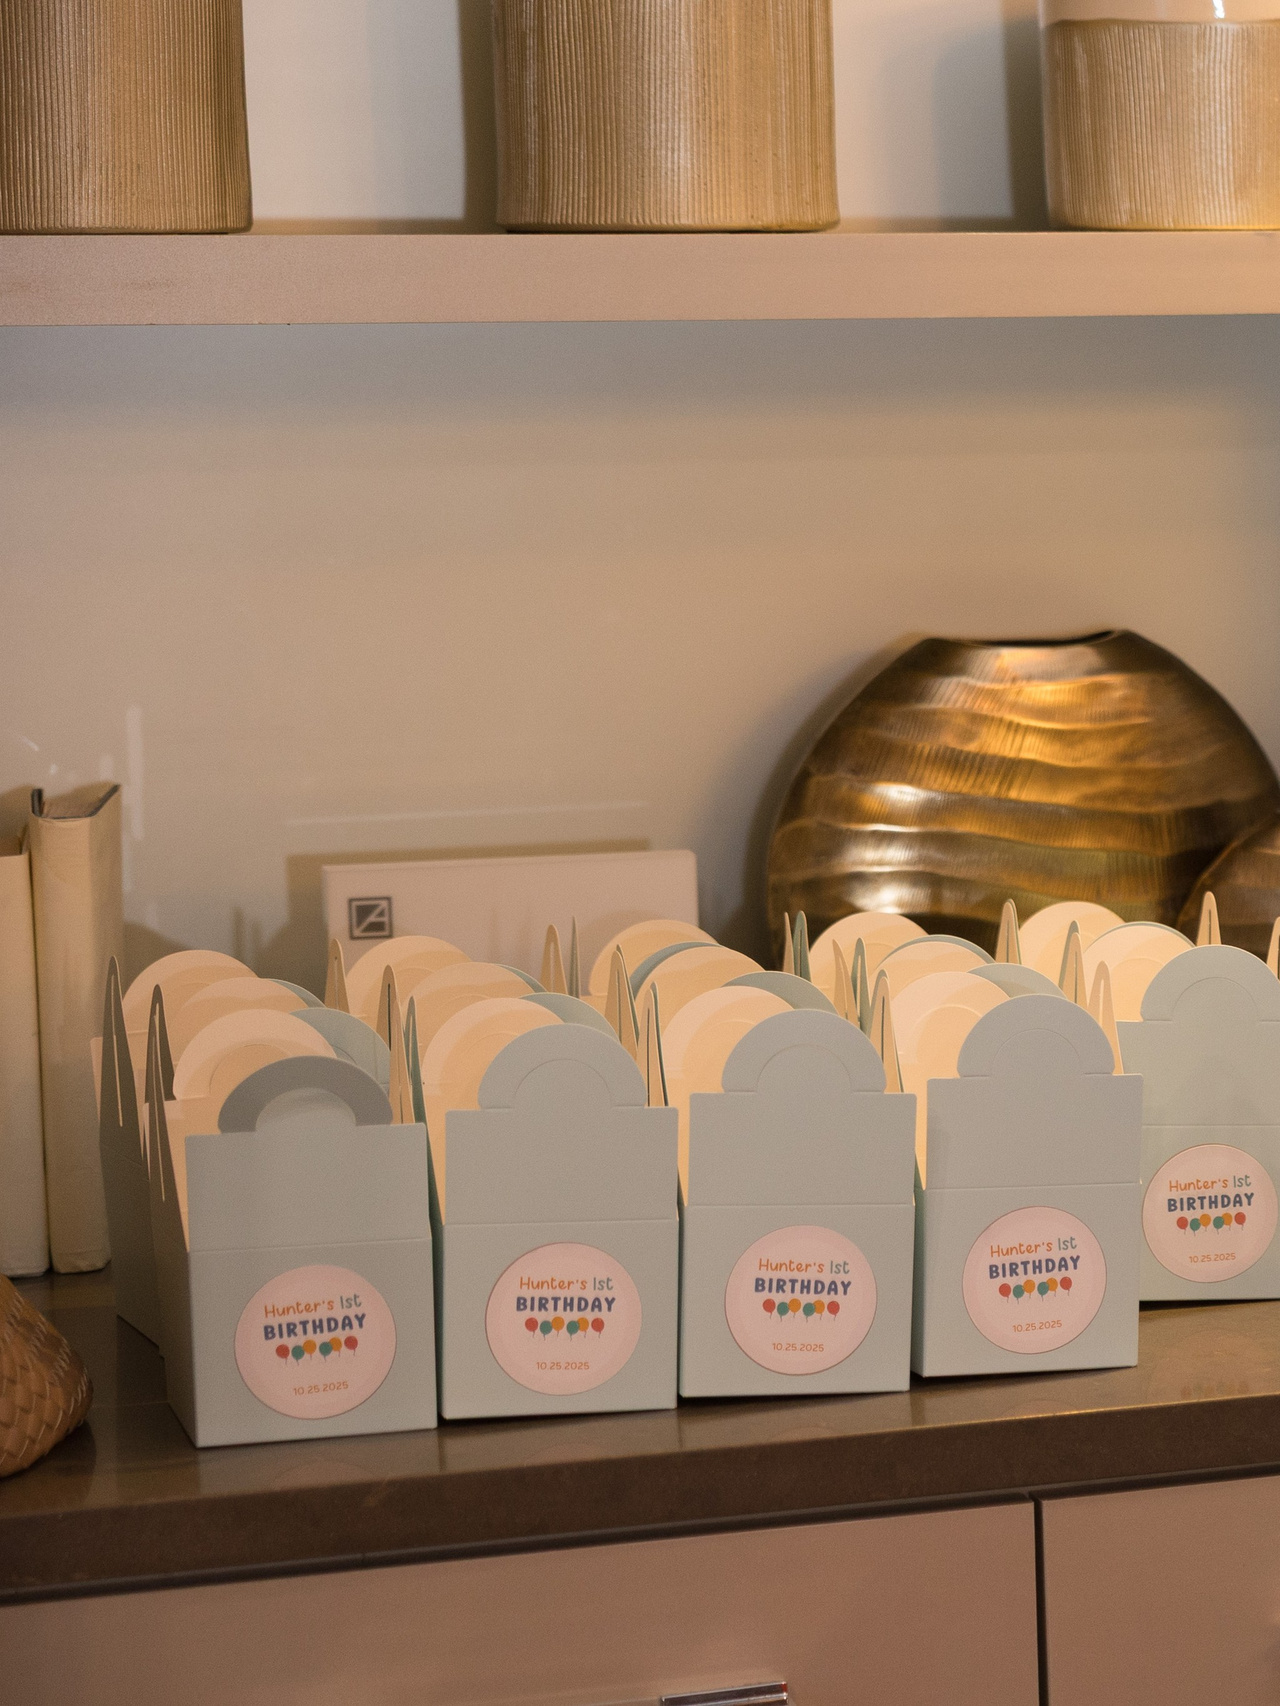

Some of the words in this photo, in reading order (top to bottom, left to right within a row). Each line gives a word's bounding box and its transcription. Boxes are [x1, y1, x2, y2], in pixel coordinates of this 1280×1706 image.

[1169, 1178, 1229, 1192] Hunter's
[1166, 1191, 1255, 1213] BIRTHDAY
[989, 1241, 1053, 1258] Hunter's
[1189, 1252, 1236, 1263] 10.25.2025
[758, 1258, 825, 1274] Hunter's
[988, 1254, 1081, 1280] BIRTHDAY
[519, 1276, 588, 1291] Hunter's
[753, 1276, 852, 1297] BIRTHDAY
[263, 1299, 335, 1319] Hunter's
[515, 1295, 617, 1314] BIRTHDAY
[262, 1312, 367, 1342] BIRTHDAY
[1012, 1319, 1063, 1333] 10.25.2025
[772, 1342, 825, 1352] 10.25.2025
[536, 1361, 590, 1370] 10.25.2025
[293, 1381, 349, 1395] 10.25.2025
